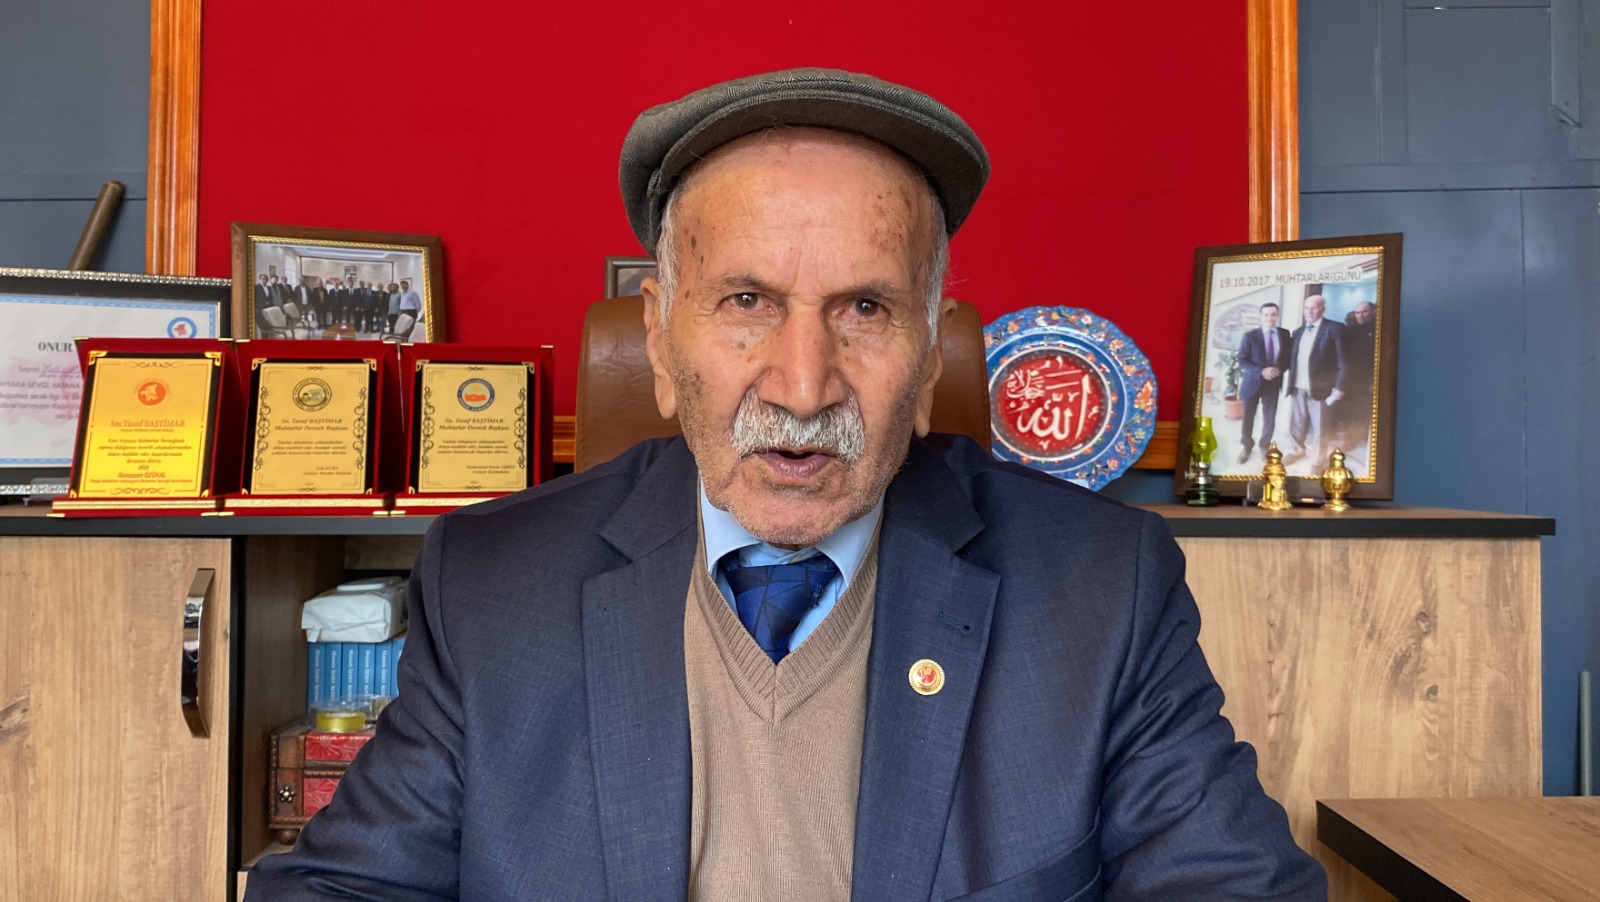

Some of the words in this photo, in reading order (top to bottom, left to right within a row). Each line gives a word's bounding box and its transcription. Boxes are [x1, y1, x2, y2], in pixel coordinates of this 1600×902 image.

[1220, 276, 1270, 288] 19.10.2017
[1275, 272, 1330, 284] MUHTARLAR
[38, 341, 72, 352] ONUR
[144, 419, 185, 428] BAŞTİMAR
